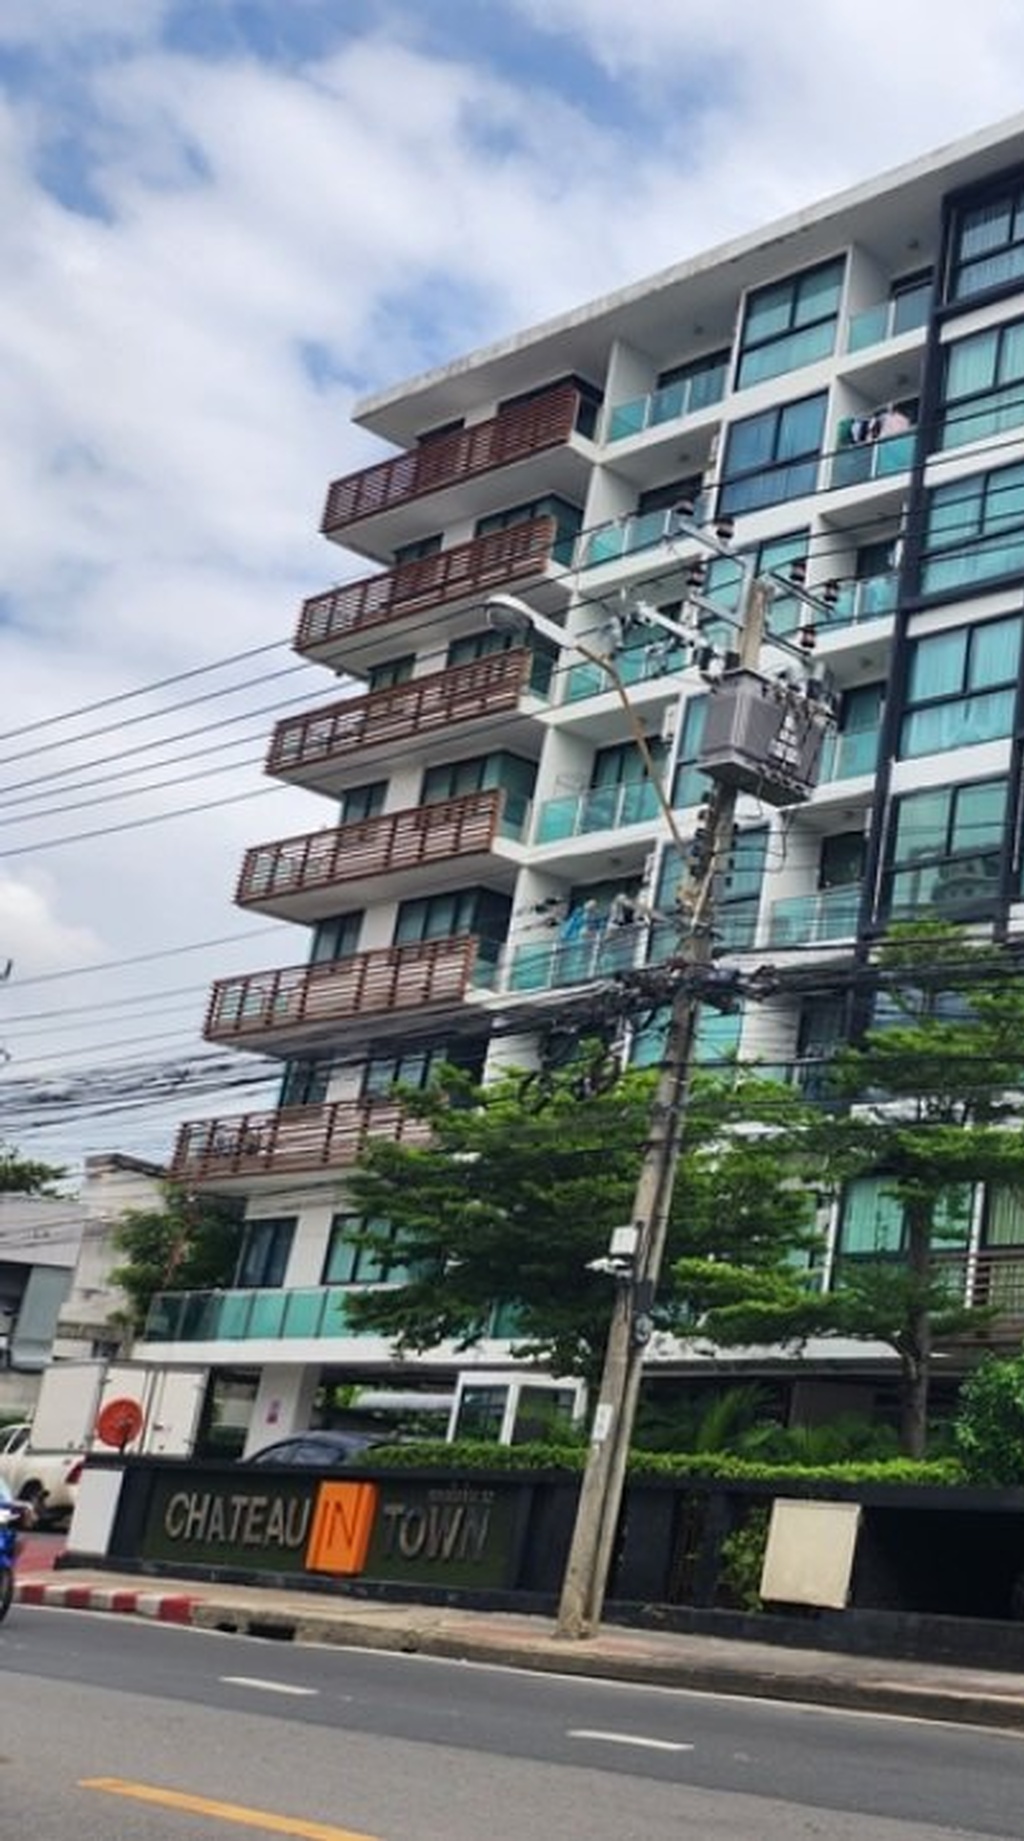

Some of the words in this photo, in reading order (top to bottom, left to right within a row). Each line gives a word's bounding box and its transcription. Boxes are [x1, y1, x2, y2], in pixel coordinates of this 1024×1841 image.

[165, 1492, 310, 1547] CHATEAU
[316, 1499, 361, 1550] IN
[385, 1504, 492, 1559] TOWN
